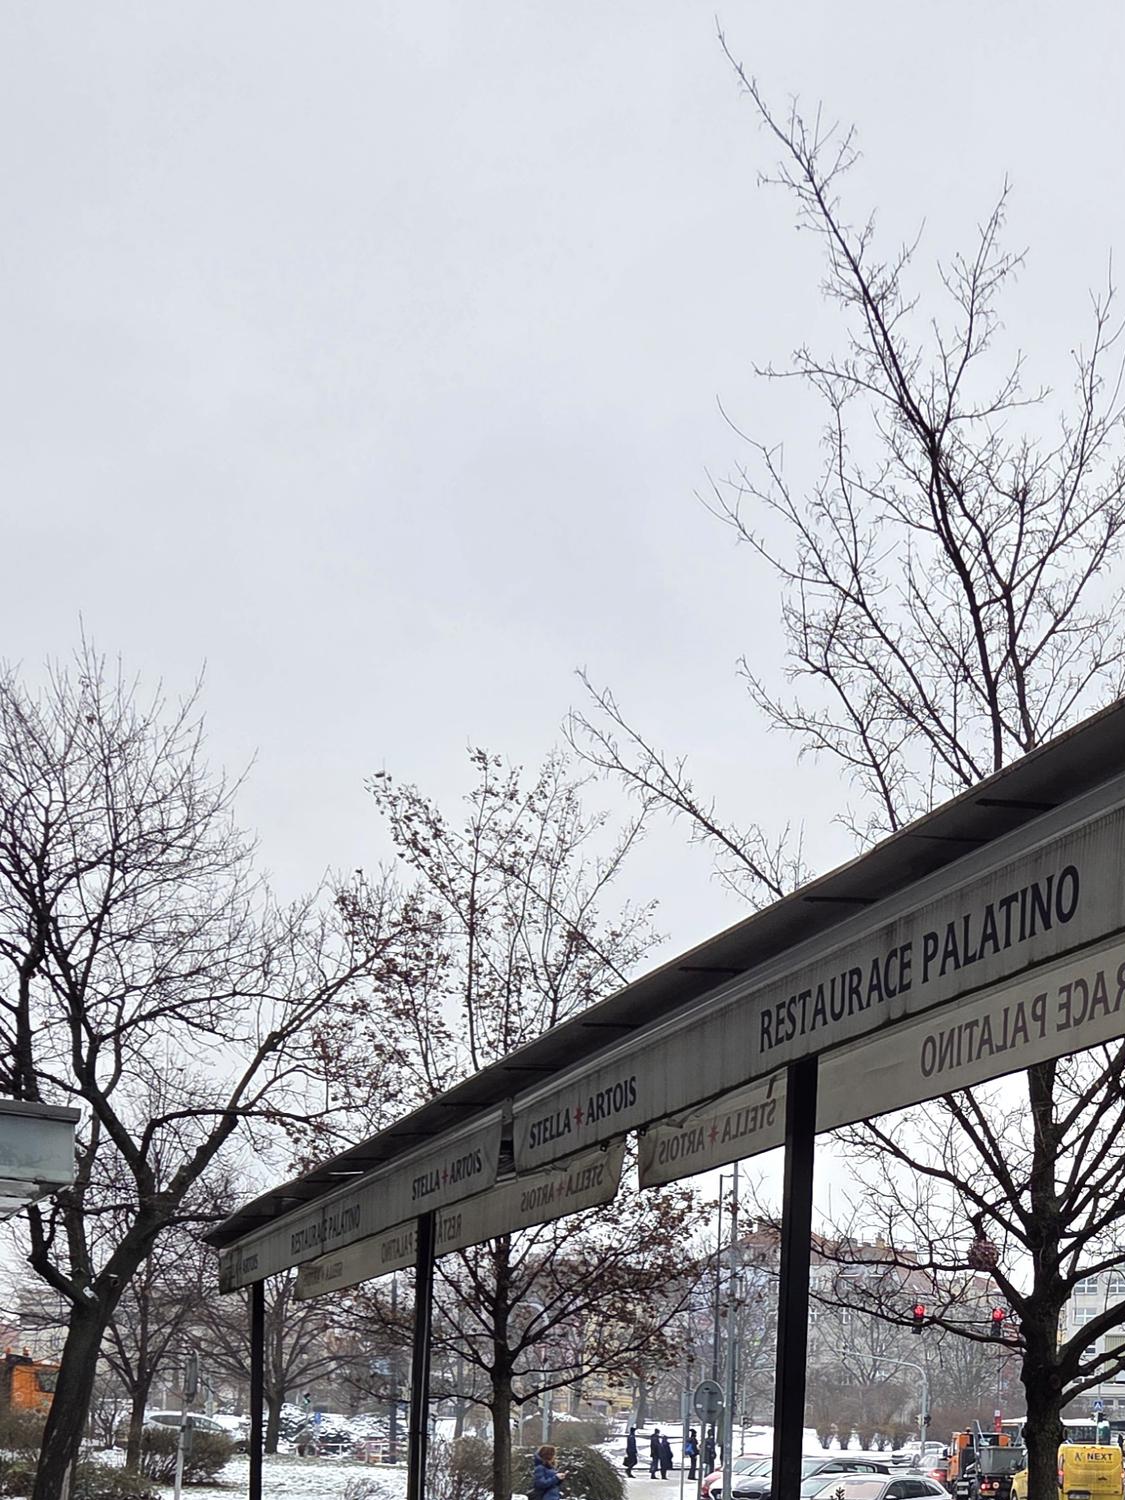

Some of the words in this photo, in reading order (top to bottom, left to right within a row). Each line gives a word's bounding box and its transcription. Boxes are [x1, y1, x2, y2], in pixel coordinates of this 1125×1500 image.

[760, 942, 912, 1052] RESTAURACE
[921, 865, 1080, 984] PALATINO
[528, 1108, 572, 1149] STELLA
[585, 1076, 637, 1126] ARTOIS
[412, 1169, 440, 1200] STELLA
[449, 1149, 482, 1184] ARTOIS
[1087, 1452, 1113, 1460] NEXT
